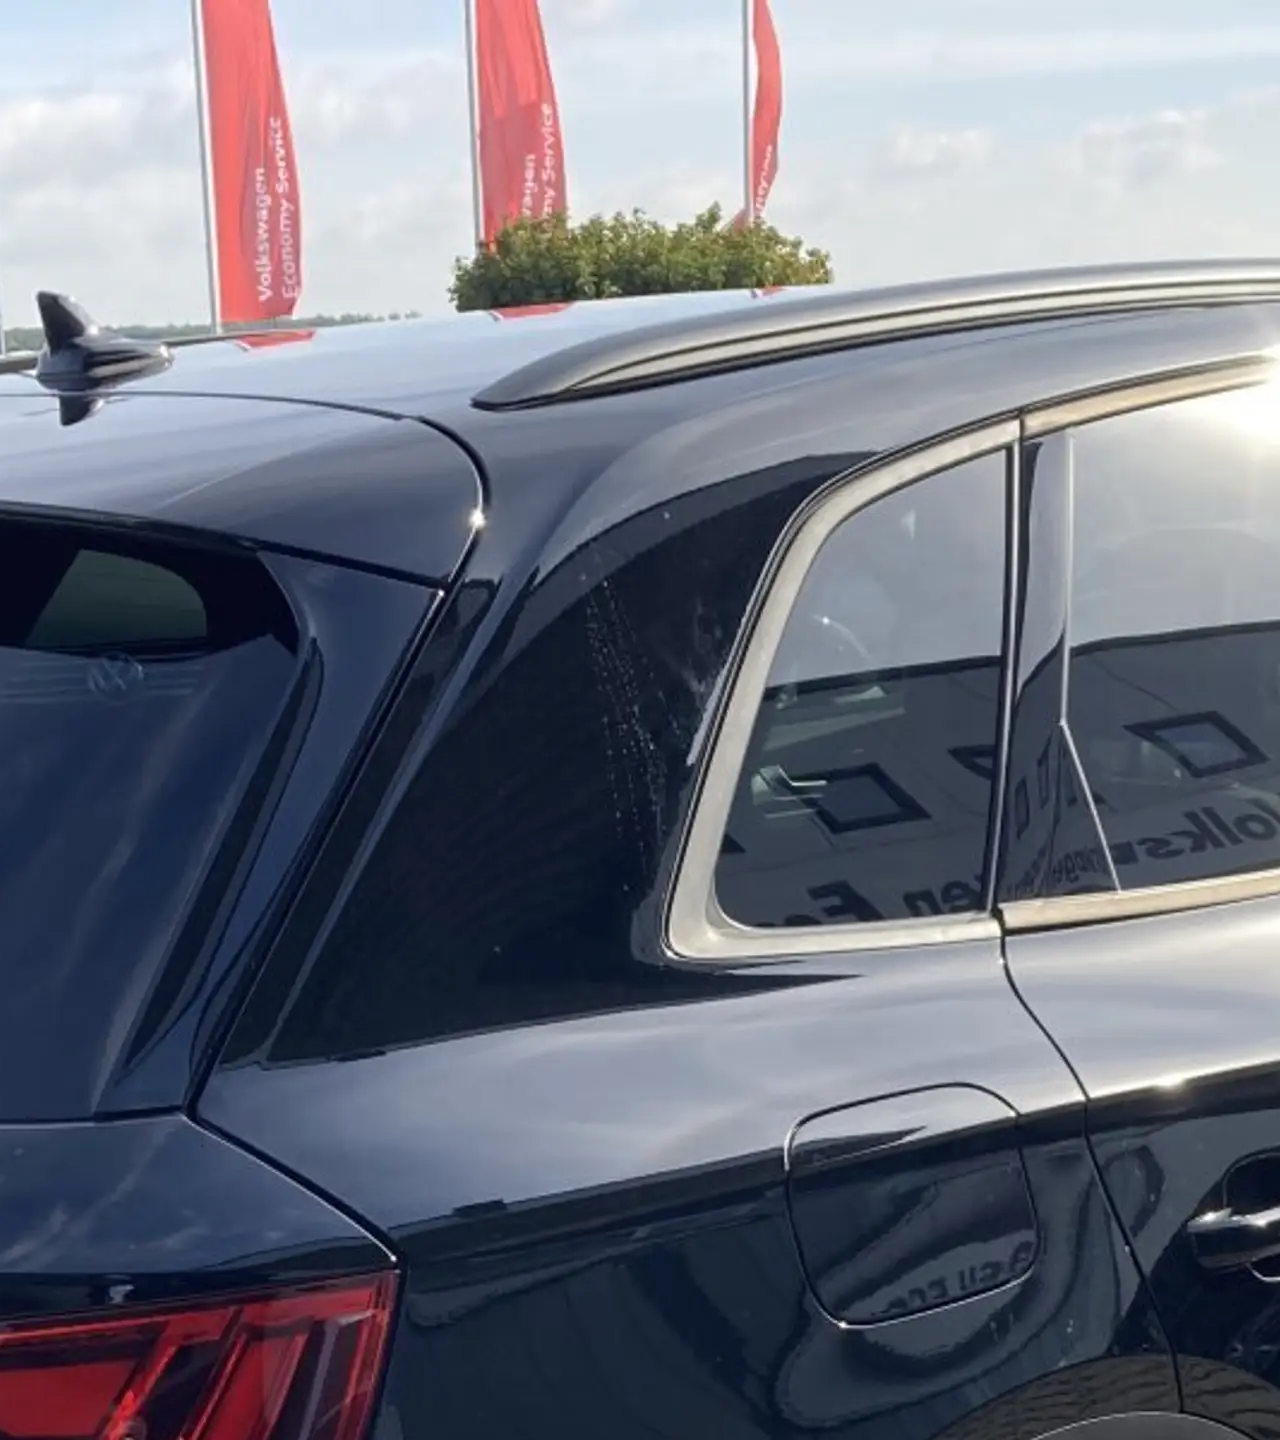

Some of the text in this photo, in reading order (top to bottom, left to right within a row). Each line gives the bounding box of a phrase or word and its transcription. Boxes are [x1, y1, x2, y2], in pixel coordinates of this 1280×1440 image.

[269, 115, 300, 300] Economy Service
[540, 102, 557, 183] Service
[254, 166, 273, 302] Volkswagen
